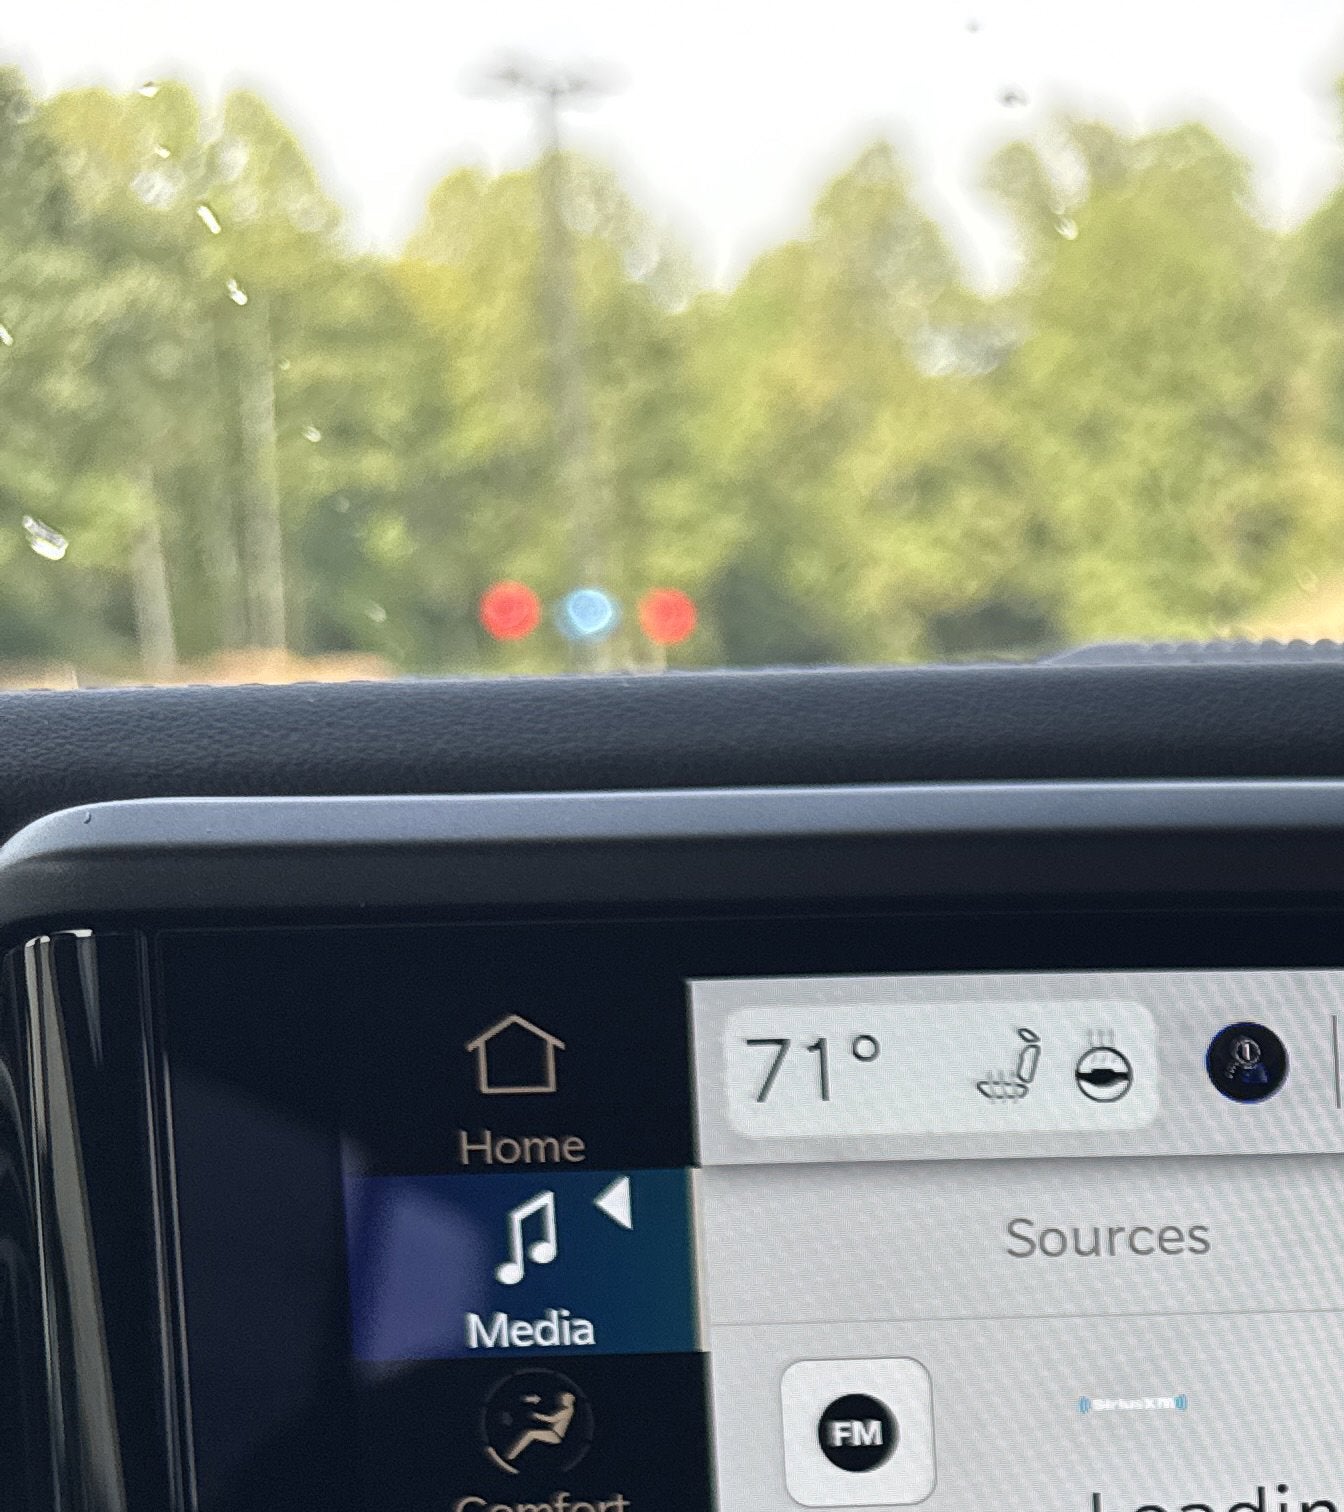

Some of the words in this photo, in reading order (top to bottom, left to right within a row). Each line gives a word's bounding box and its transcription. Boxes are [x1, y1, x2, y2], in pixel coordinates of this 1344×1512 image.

[458, 1131, 586, 1165] Home
[1007, 1217, 1212, 1259] Sources
[465, 1309, 596, 1348] Media
[830, 1419, 883, 1447] FM
